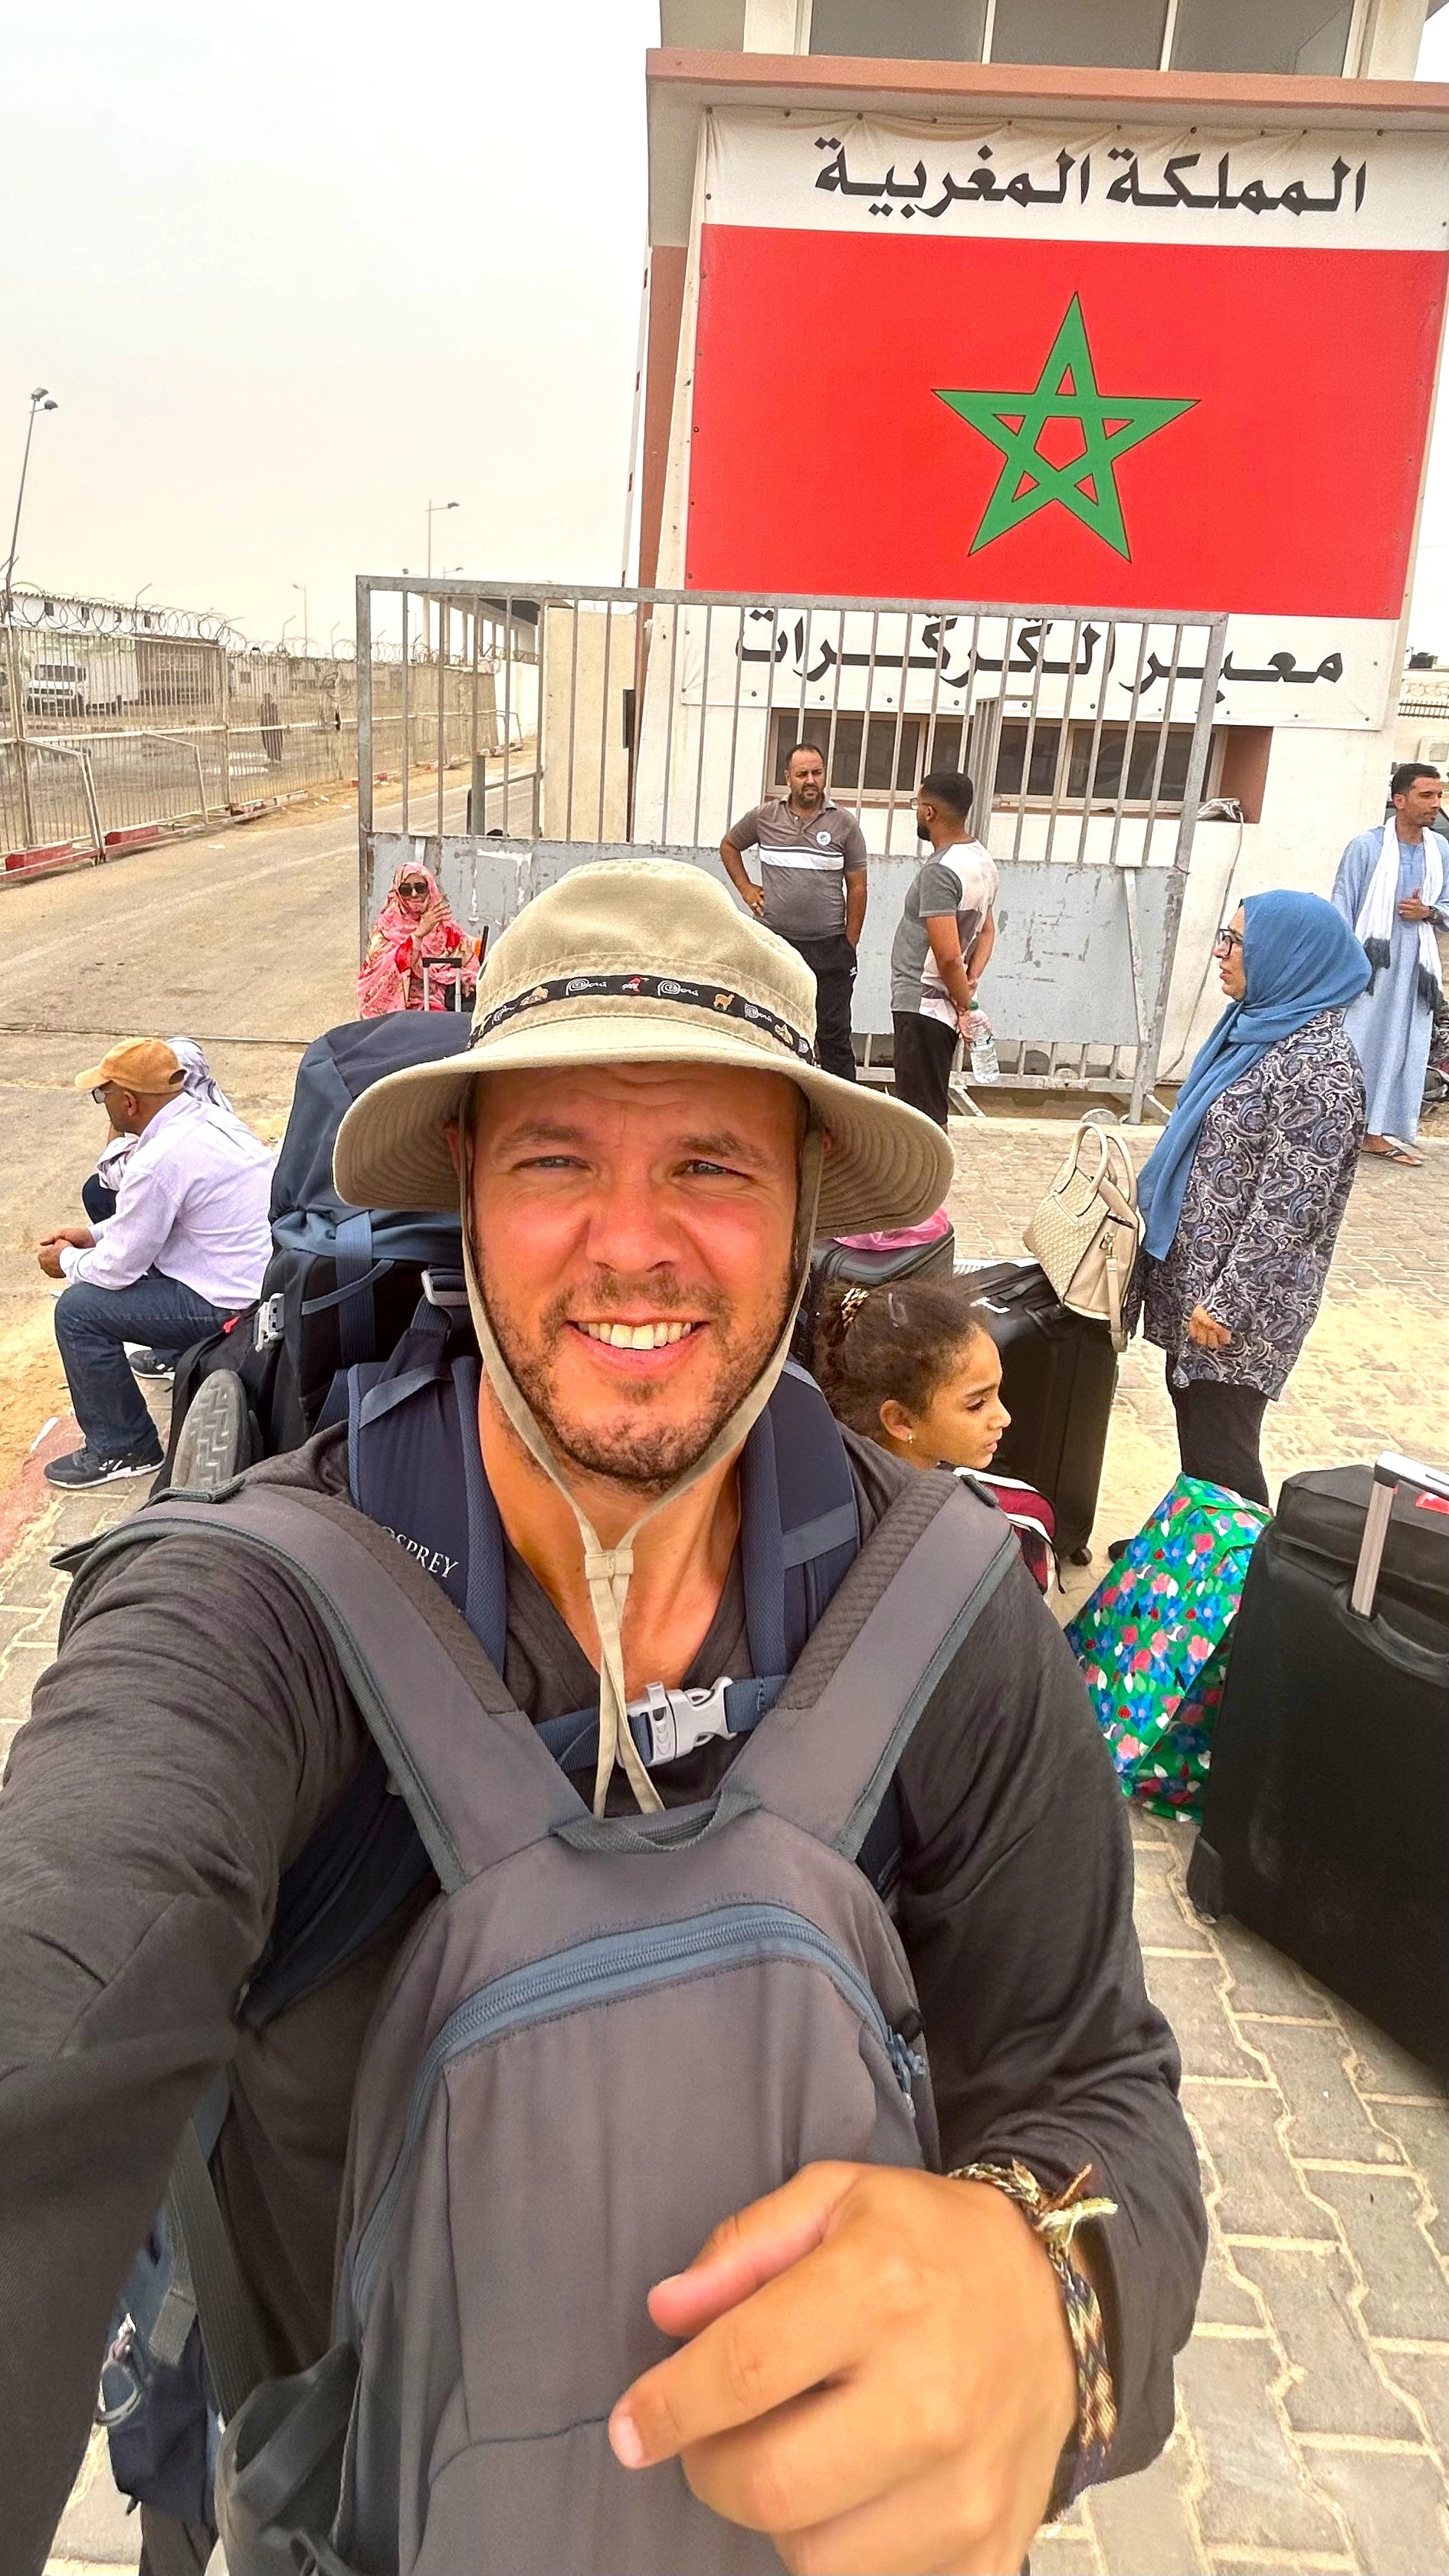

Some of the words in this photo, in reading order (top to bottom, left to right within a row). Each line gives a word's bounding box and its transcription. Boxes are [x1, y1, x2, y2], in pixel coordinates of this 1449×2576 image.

[814, 137, 1090, 218] المغربية
[1106, 148, 1366, 216] المملكة
[1118, 651, 1344, 704] معبر
